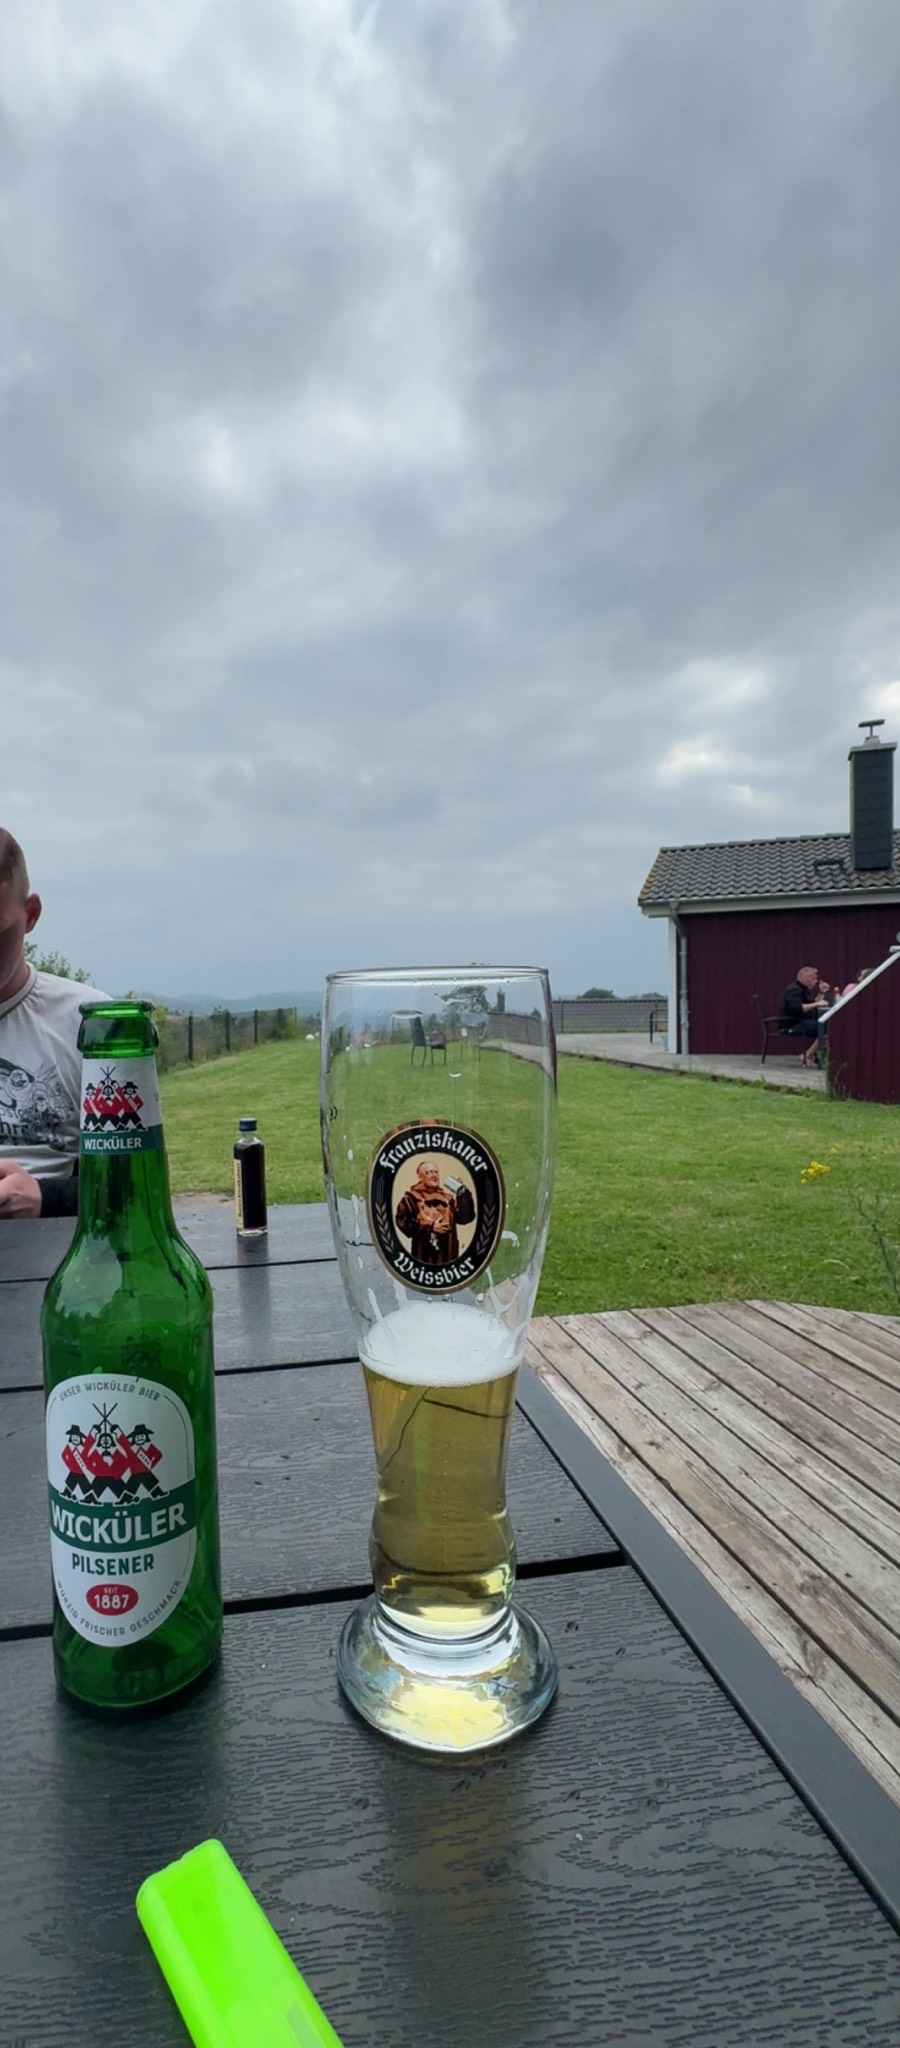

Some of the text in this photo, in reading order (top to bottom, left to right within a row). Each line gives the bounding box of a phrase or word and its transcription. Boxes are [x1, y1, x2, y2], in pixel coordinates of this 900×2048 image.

[84, 1137, 143, 1151] WICKÜLER
[379, 1130, 488, 1174] Franziskaner
[394, 1252, 476, 1285] Weissbier
[59, 1380, 160, 1401] UNSER WICKÜLER BIER
[51, 1500, 187, 1545] WICKÜLER
[71, 1552, 154, 1576] PILSENER
[80, 1617, 125, 1637] FRISCHER
[129, 1579, 181, 1632] GESCHMACK
[94, 1594, 129, 1609] 1887
